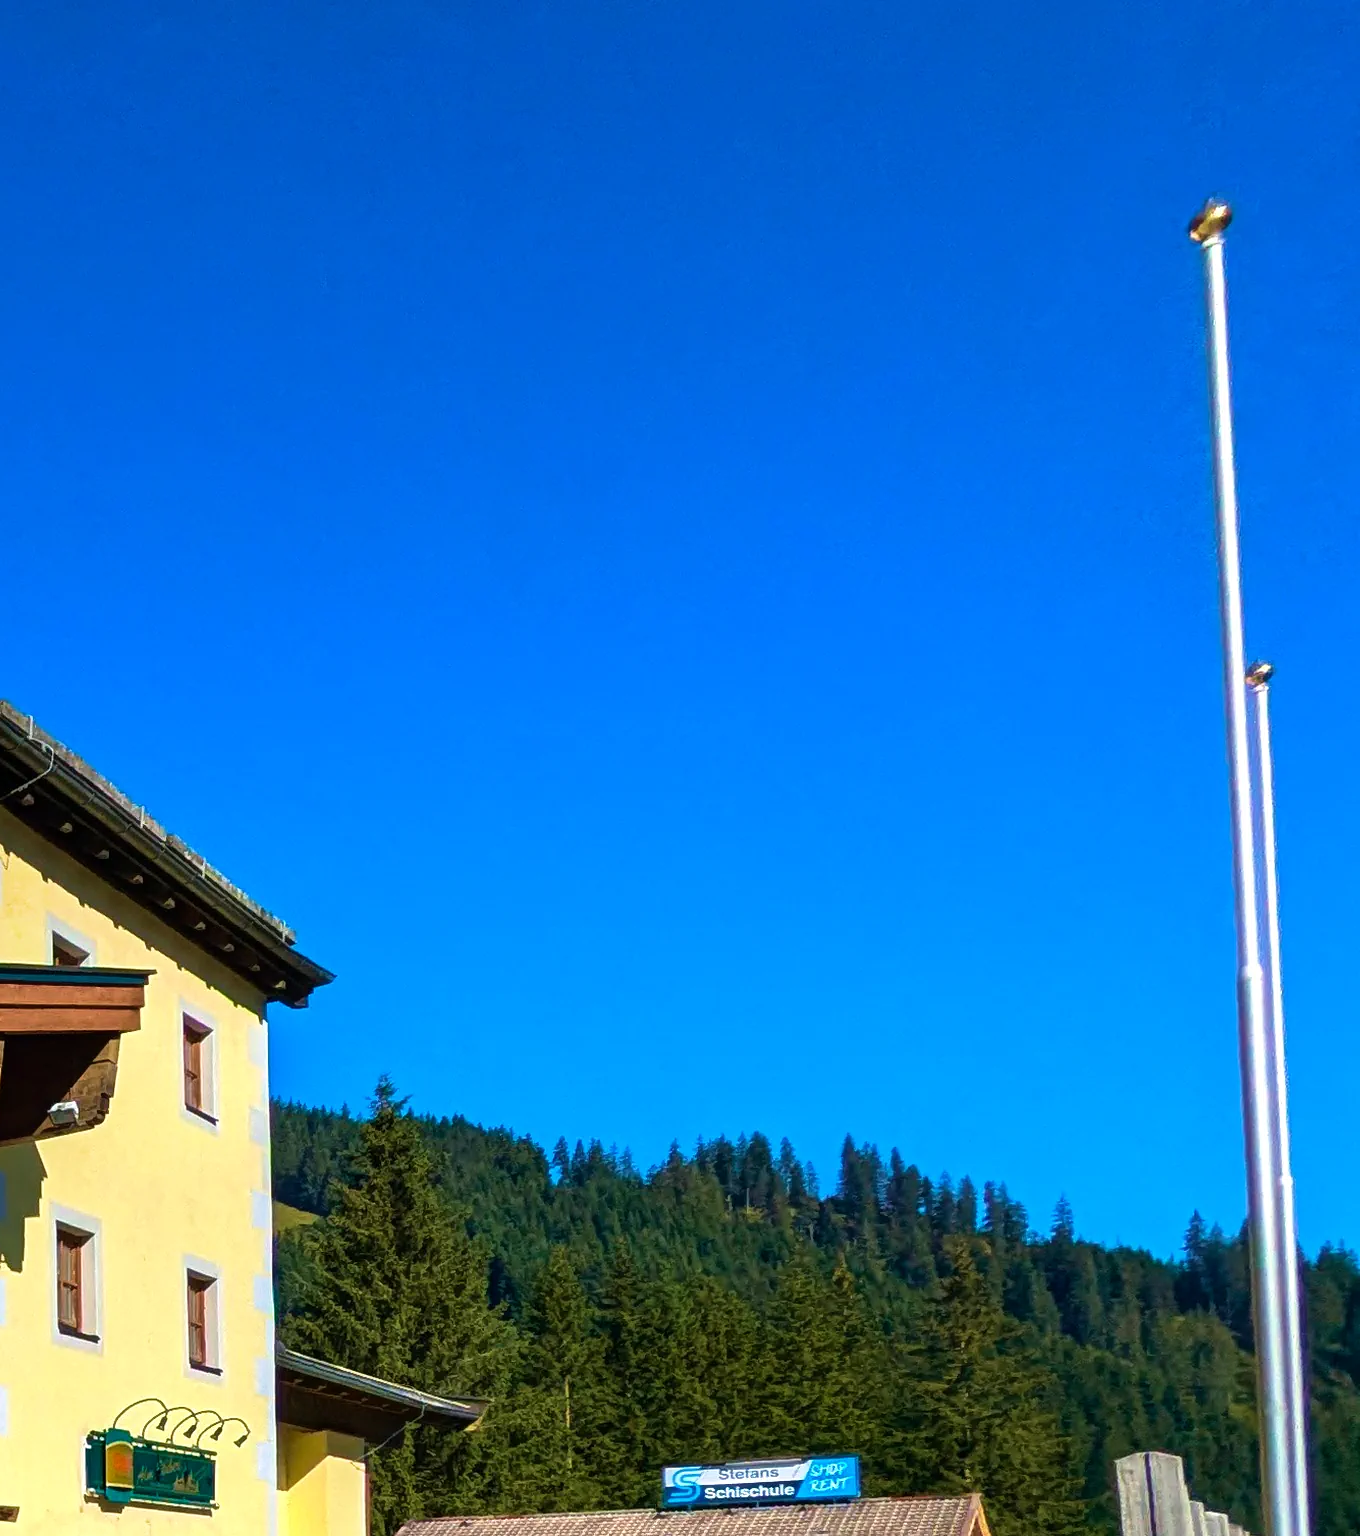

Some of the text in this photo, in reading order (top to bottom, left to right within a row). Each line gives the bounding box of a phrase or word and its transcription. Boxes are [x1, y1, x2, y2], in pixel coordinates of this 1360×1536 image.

[718, 1467, 779, 1480] Stefans
[810, 1463, 848, 1477] SHOP
[810, 1476, 849, 1492] RENT
[704, 1484, 795, 1500] Schischule
